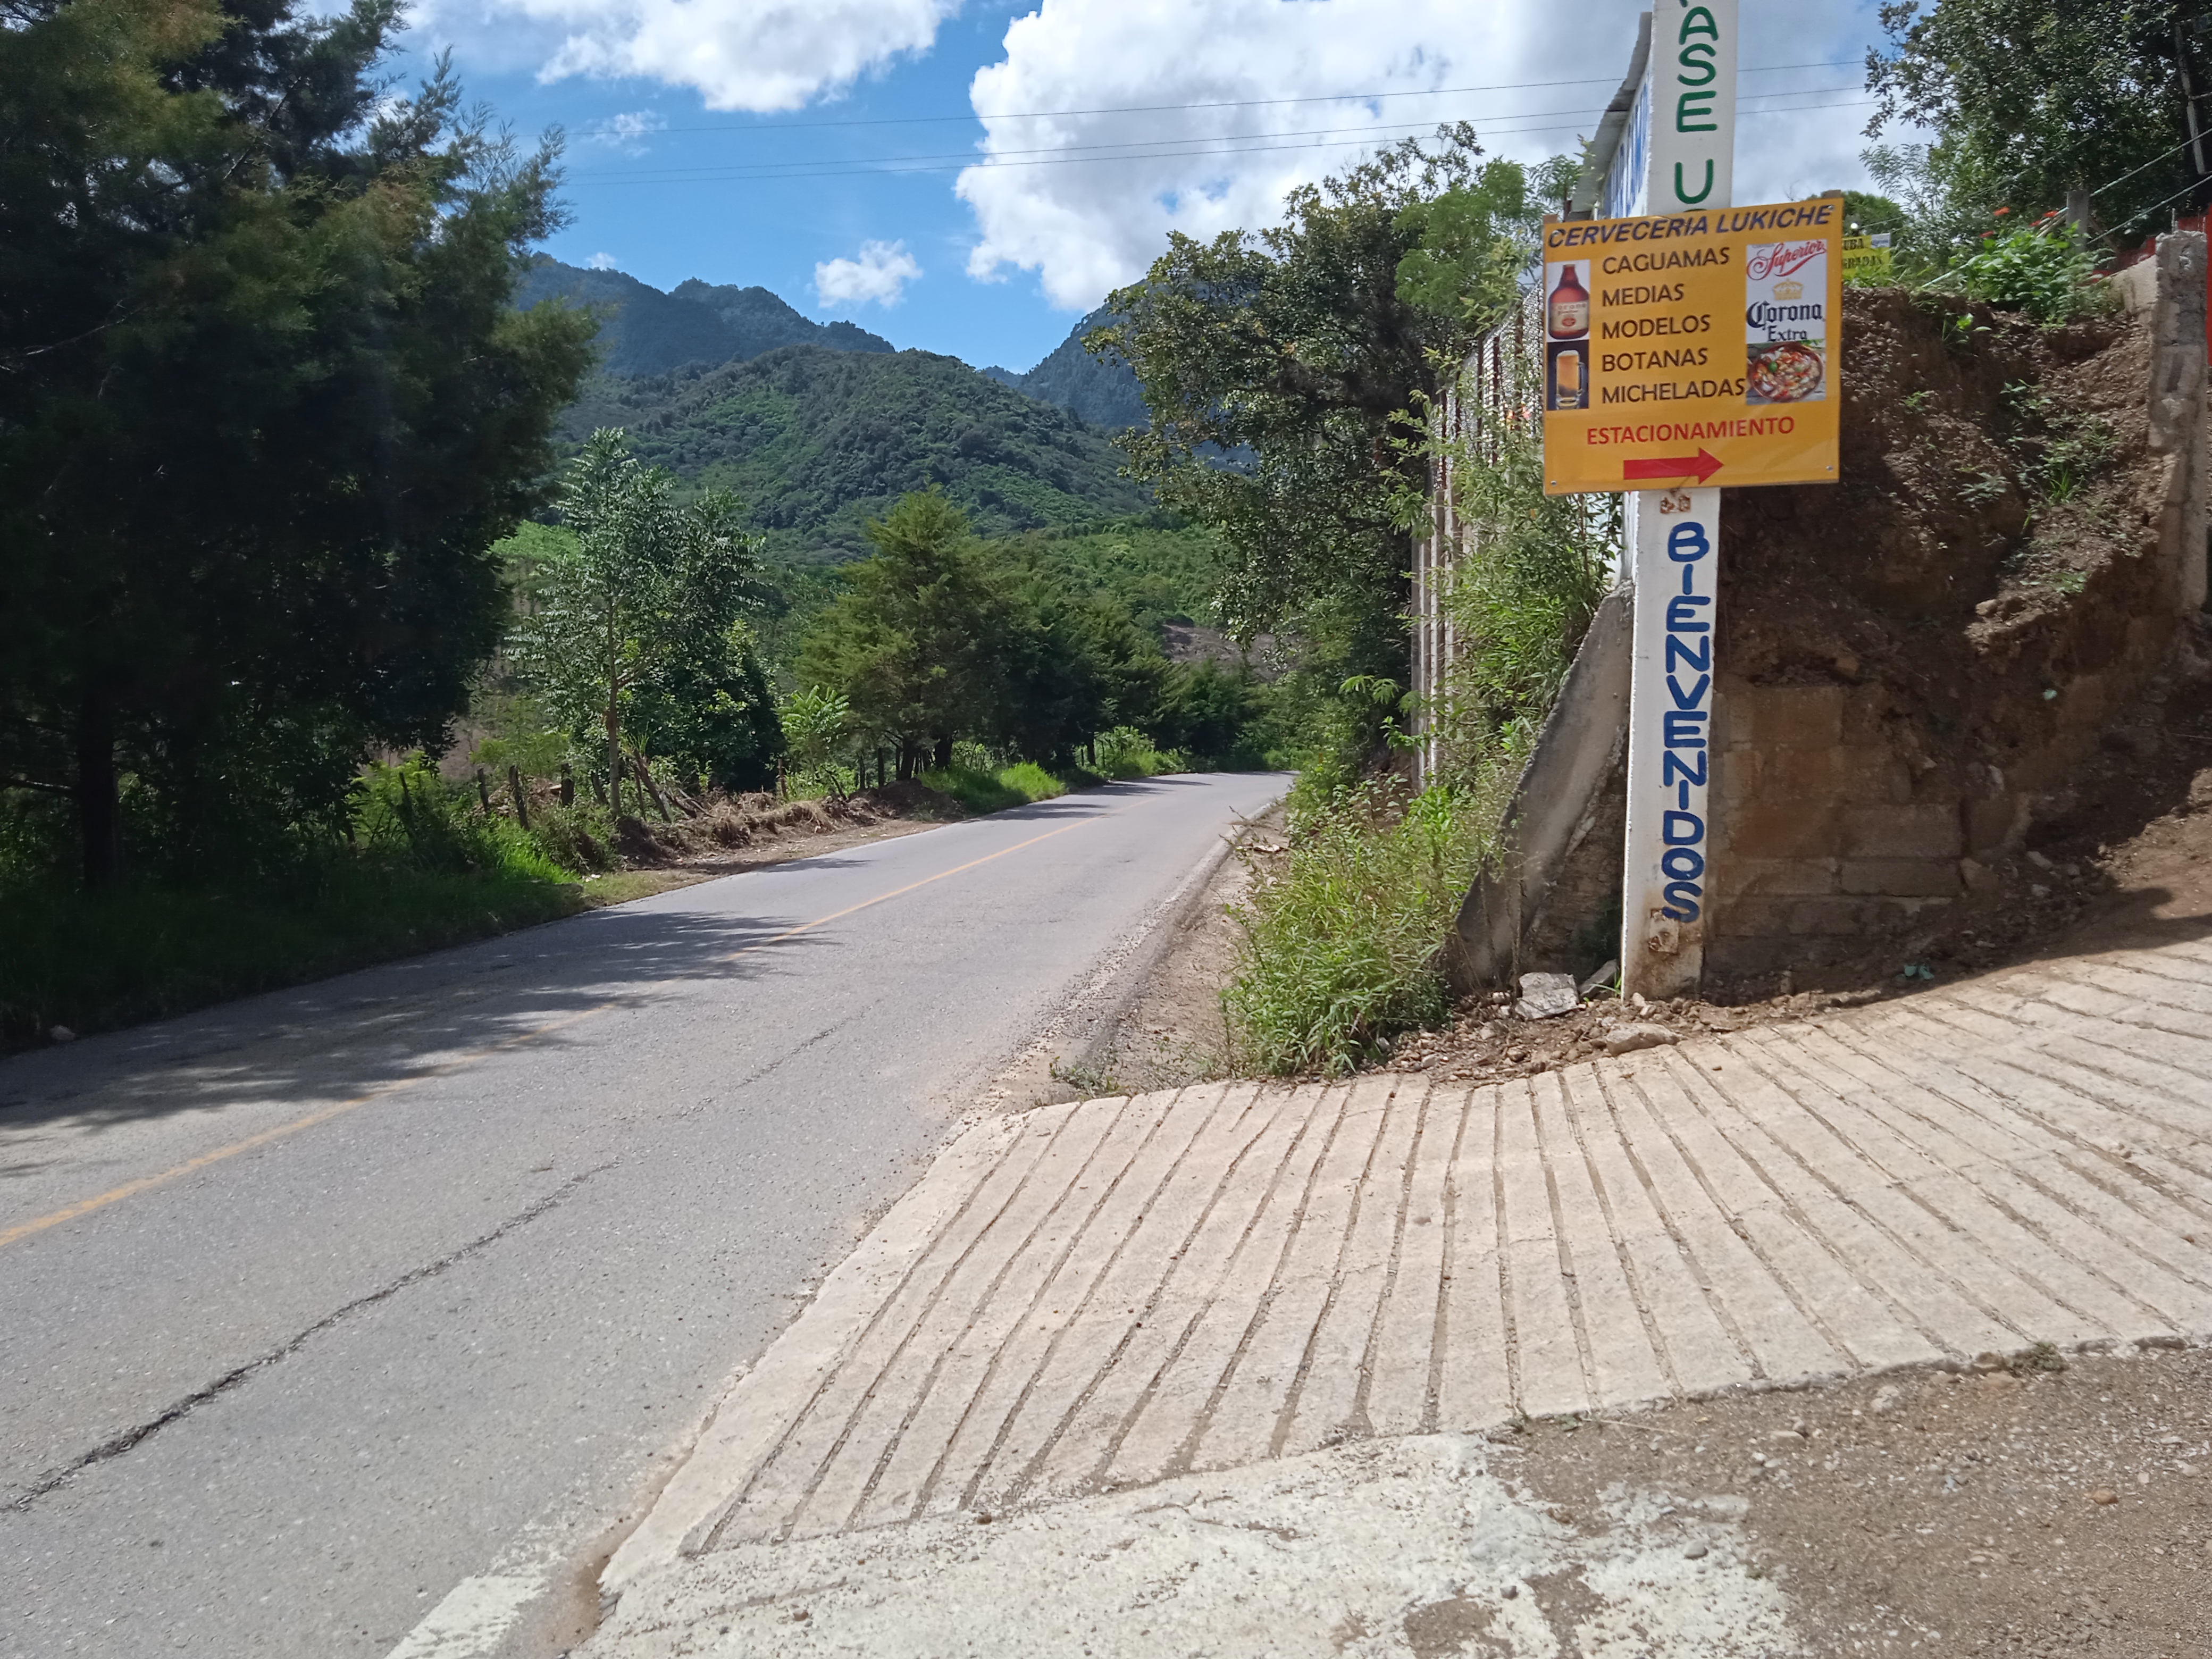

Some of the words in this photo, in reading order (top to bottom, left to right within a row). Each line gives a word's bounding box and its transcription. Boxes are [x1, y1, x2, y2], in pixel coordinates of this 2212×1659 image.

[1677, 0, 1719, 133] ASE
[1674, 158, 1714, 213] U
[1548, 216, 1707, 248] CERVECERIA
[1716, 205, 1833, 233] LUKICHE
[1602, 247, 1730, 275] CAGUAMAS
[1746, 240, 1827, 281] Superior
[1602, 283, 1685, 307] MEDIAS
[1602, 314, 1710, 339] MODELOS
[1746, 300, 1823, 331] Corona
[1767, 325, 1808, 342] Extra
[1602, 348, 1708, 372] BOTANAS
[1602, 378, 1746, 404] MICHELADAS
[1587, 416, 1795, 445] ESTACIONAMIENTO
[1661, 521, 1711, 924] BIENVENIDOS
